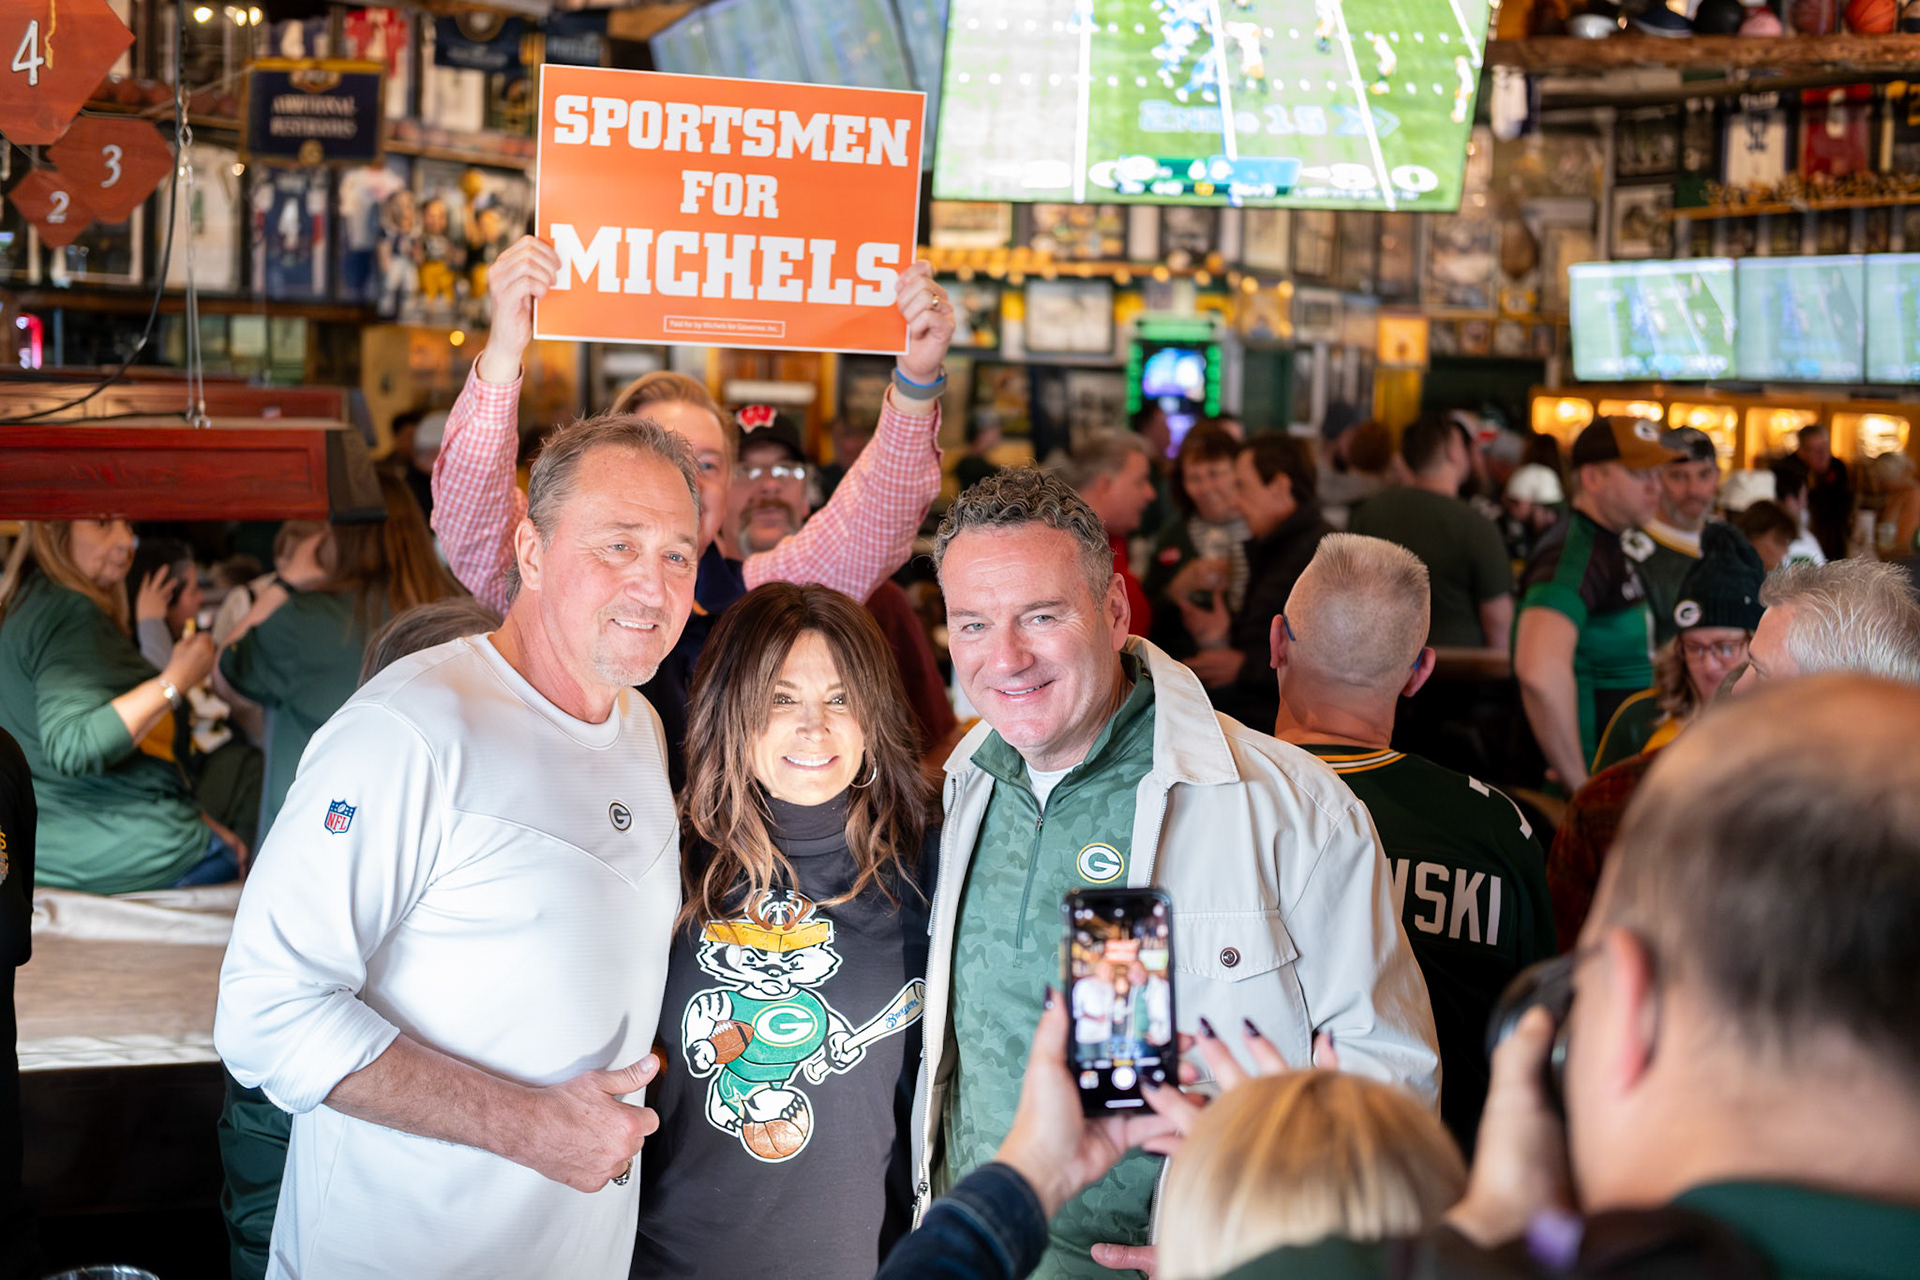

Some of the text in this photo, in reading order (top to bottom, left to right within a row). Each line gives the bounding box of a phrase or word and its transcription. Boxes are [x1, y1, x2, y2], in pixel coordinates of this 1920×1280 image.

[11, 19, 45, 86] 4
[554, 94, 911, 167] SPORTSMEN
[101, 144, 123, 188] 3
[46, 190, 70, 224] 2
[680, 169, 779, 218] FOR
[550, 223, 900, 307] MICHELS
[326, 811, 347, 832] NFL
[609, 801, 632, 832] G
[1078, 844, 1122, 881] G
[754, 1005, 816, 1045] G
